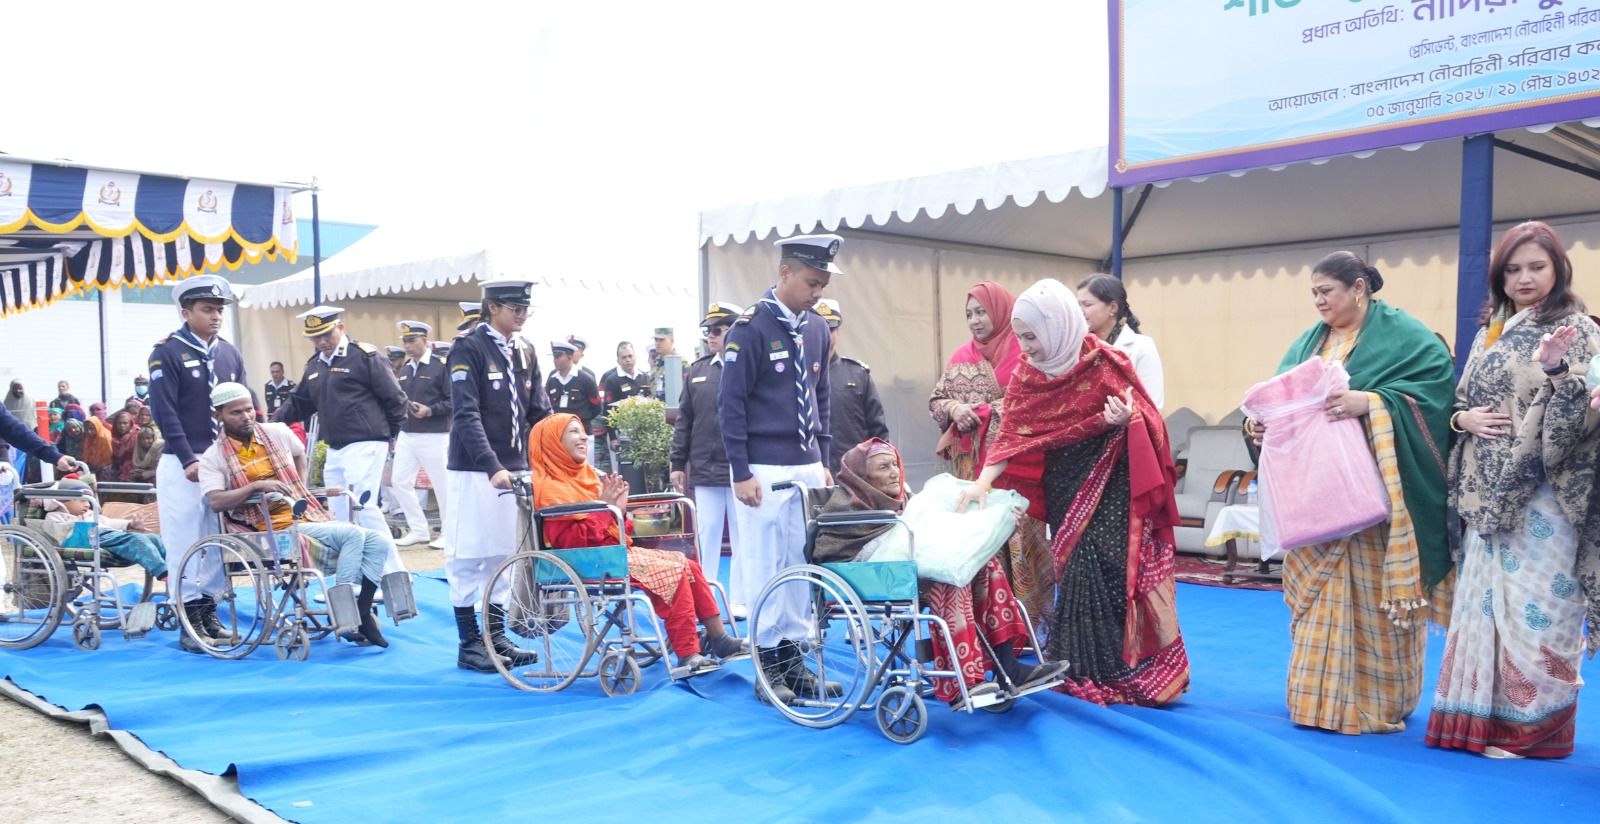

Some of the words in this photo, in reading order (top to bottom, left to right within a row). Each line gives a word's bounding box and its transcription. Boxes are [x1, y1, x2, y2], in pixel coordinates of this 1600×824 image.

[1302, 21, 1341, 44] প্রধান
[1460, 26, 1512, 48] বাংলাদেশ
[1515, 11, 1565, 38] নৌবাহিনী
[1350, 72, 1424, 96] বাংলাদেশ
[1429, 53, 1503, 83] নৌবাহিনী
[1508, 47, 1572, 67] পরিবার
[1366, 104, 1385, 118] ০৫
[1388, 91, 1442, 116] জানুয়ারি
[1446, 88, 1484, 105] ২০২৬
[1498, 83, 1517, 96] ২১
[1521, 75, 1553, 92] পৌষ
